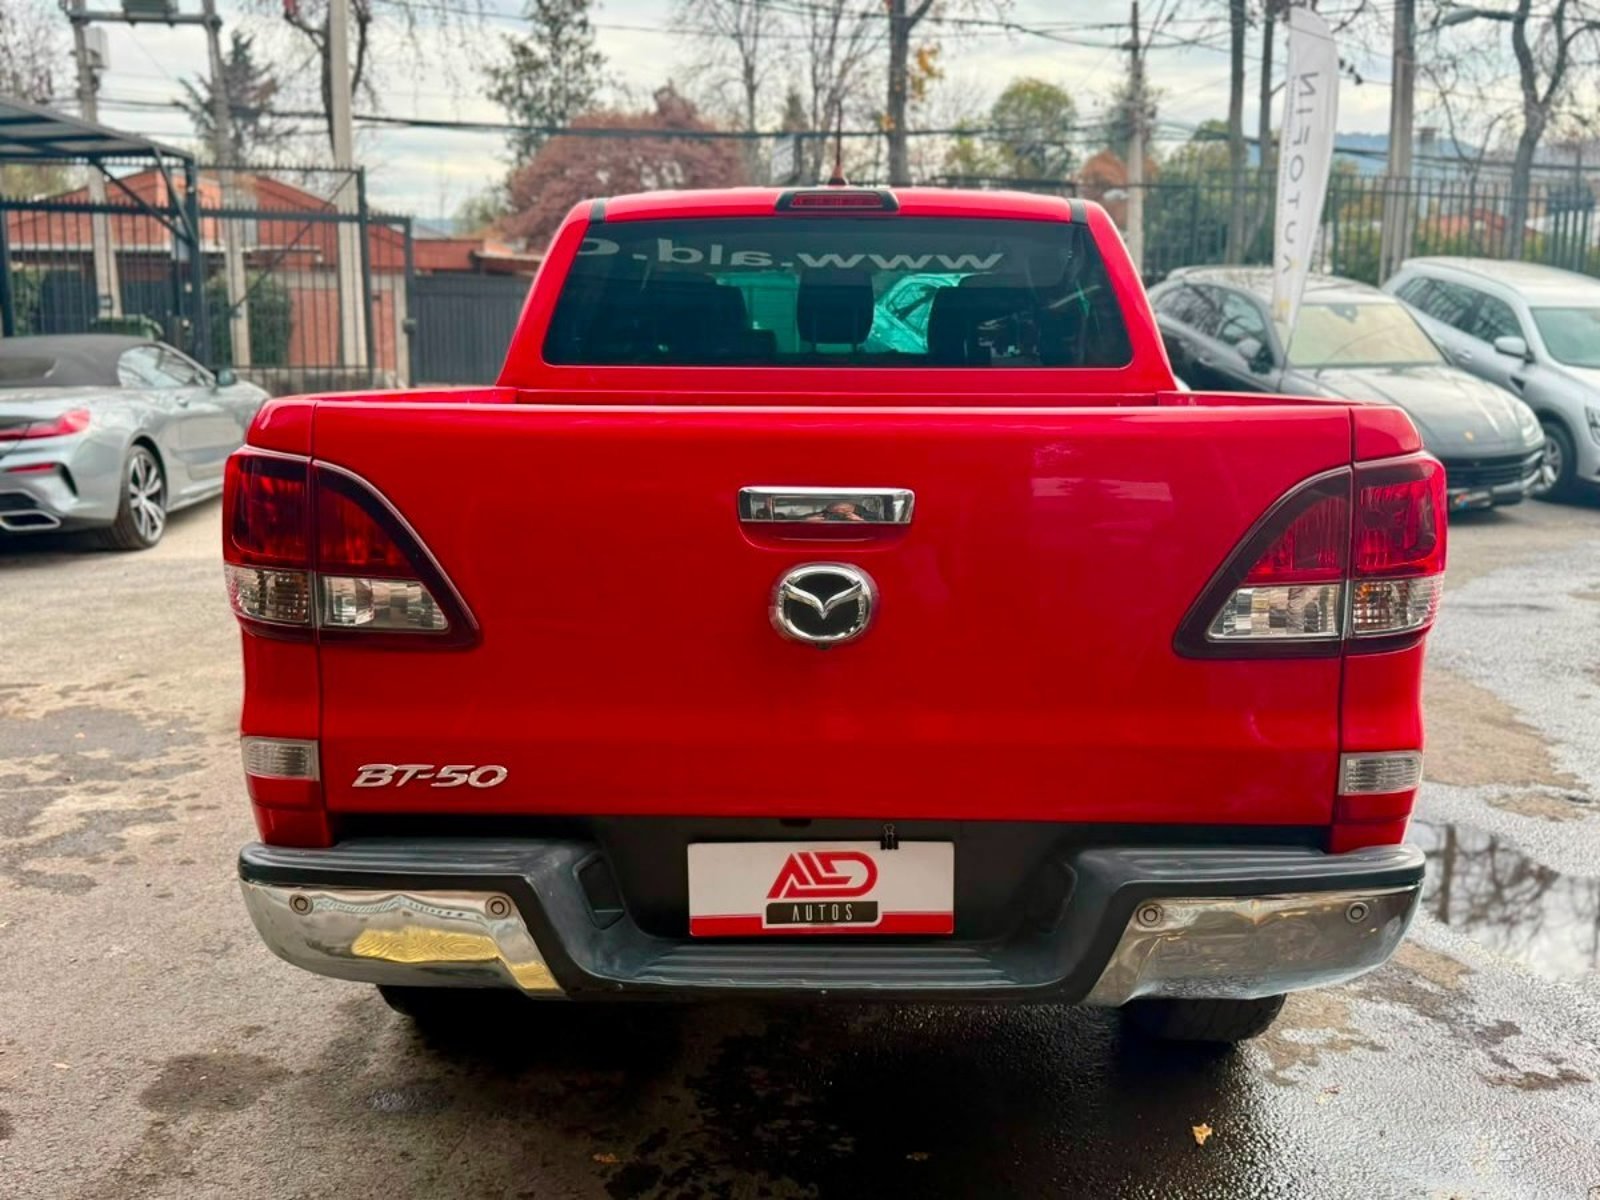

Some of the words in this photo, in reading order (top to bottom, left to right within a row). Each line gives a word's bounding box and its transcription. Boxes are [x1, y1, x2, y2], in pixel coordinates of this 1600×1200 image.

[352, 763, 508, 788] BT-50
[766, 851, 878, 899] ALD
[792, 904, 853, 922] AUTOS
